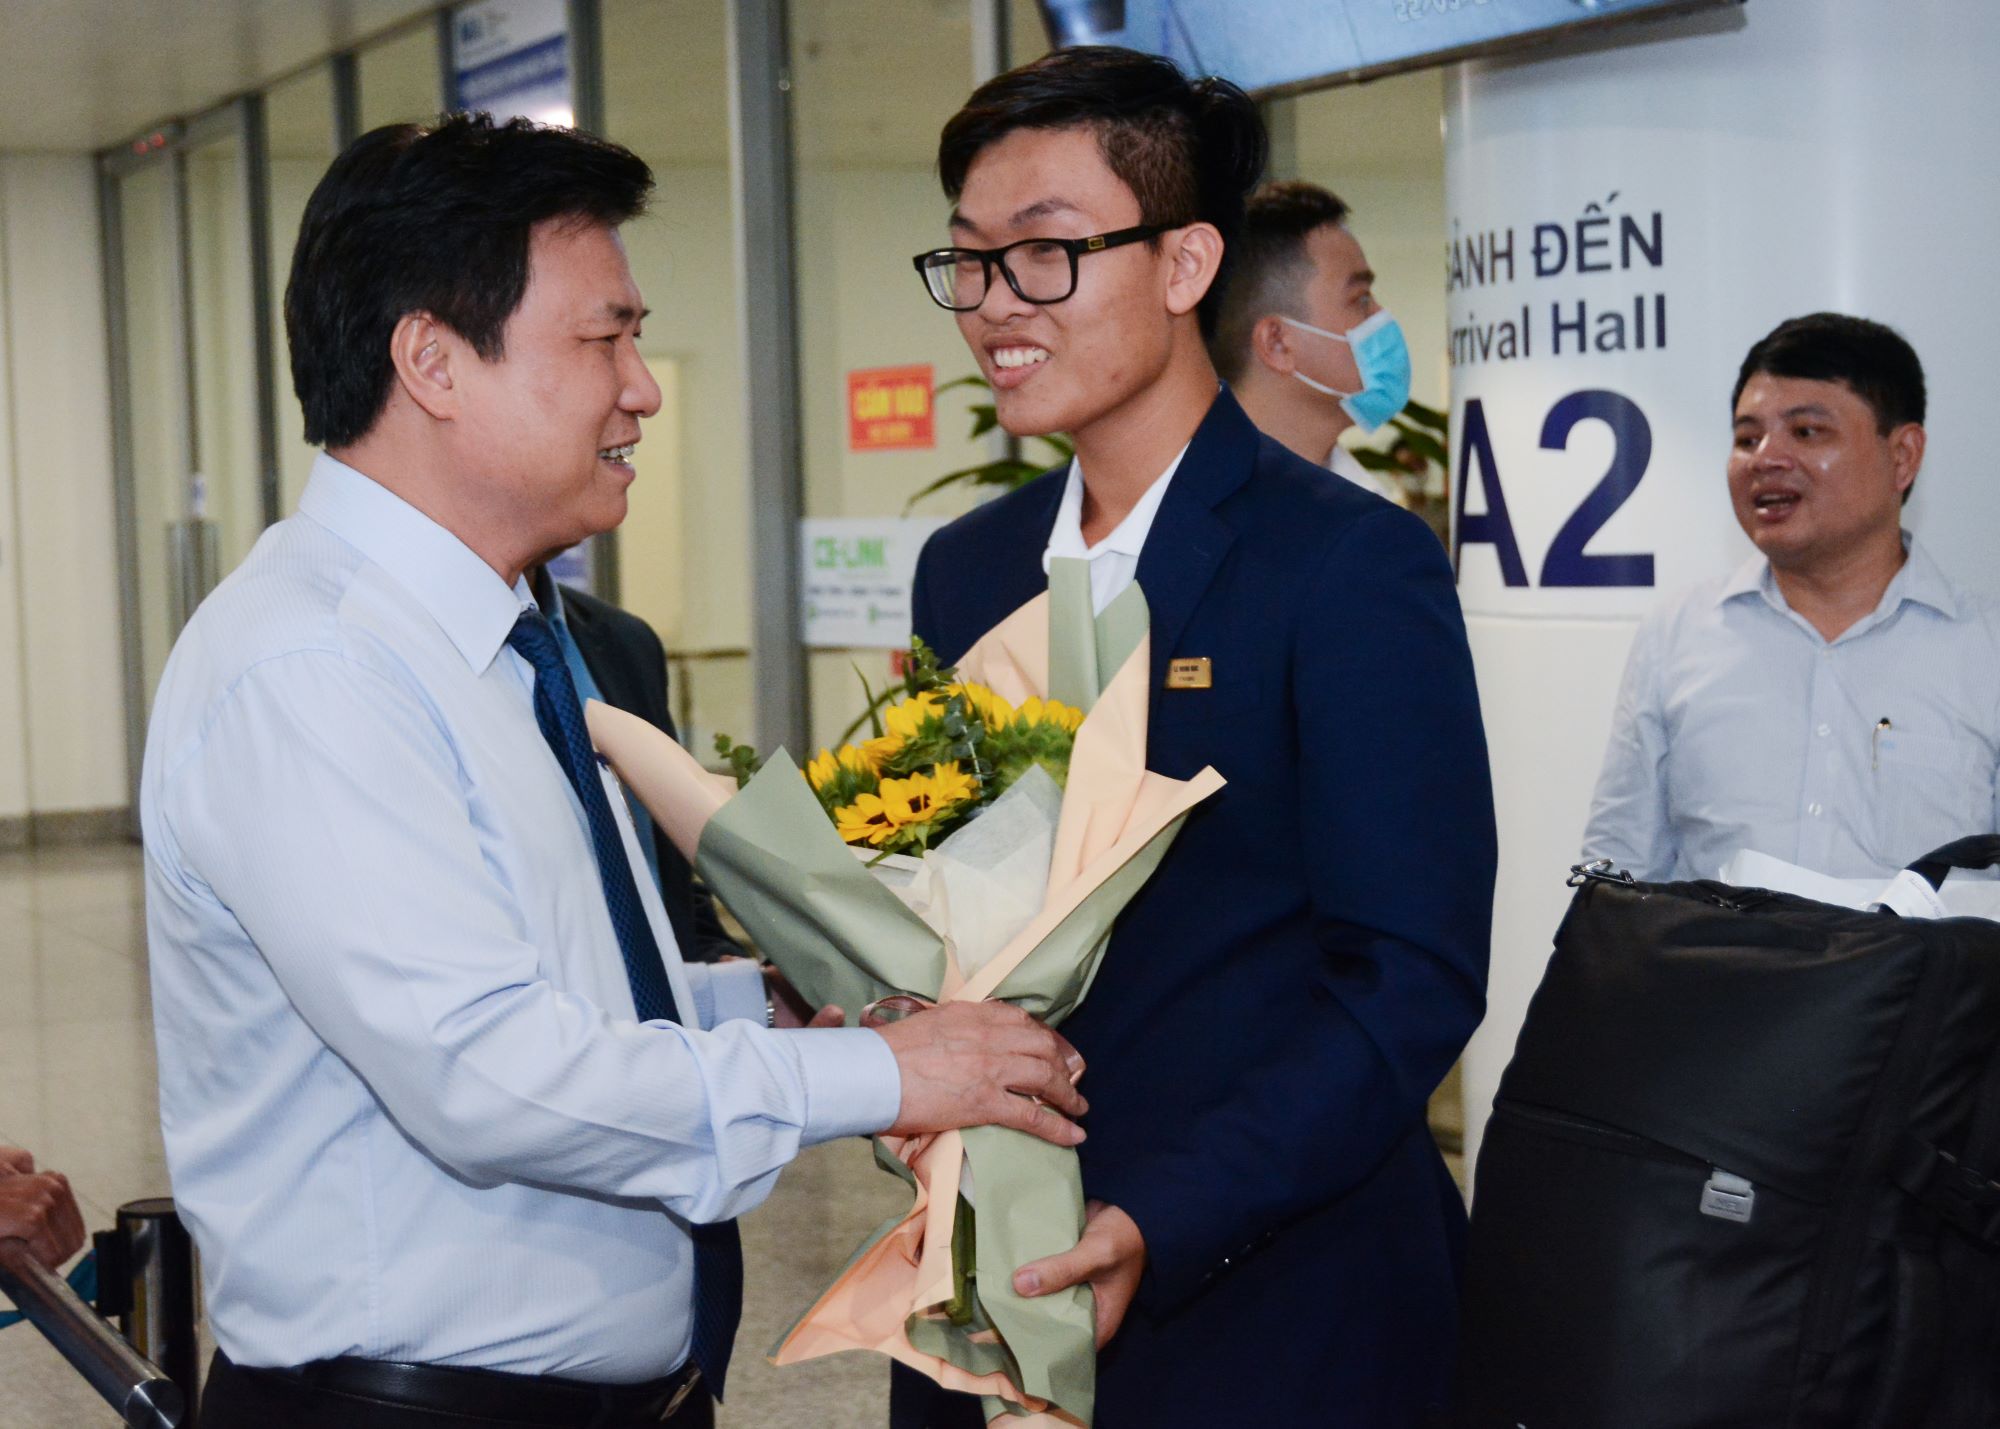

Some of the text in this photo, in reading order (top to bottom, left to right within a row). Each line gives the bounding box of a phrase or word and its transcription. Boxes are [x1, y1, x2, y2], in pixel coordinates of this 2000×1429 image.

[1531, 191, 1663, 278] ĐẾN
[1551, 294, 1666, 356] Hall
[1455, 389, 1655, 588] A2
